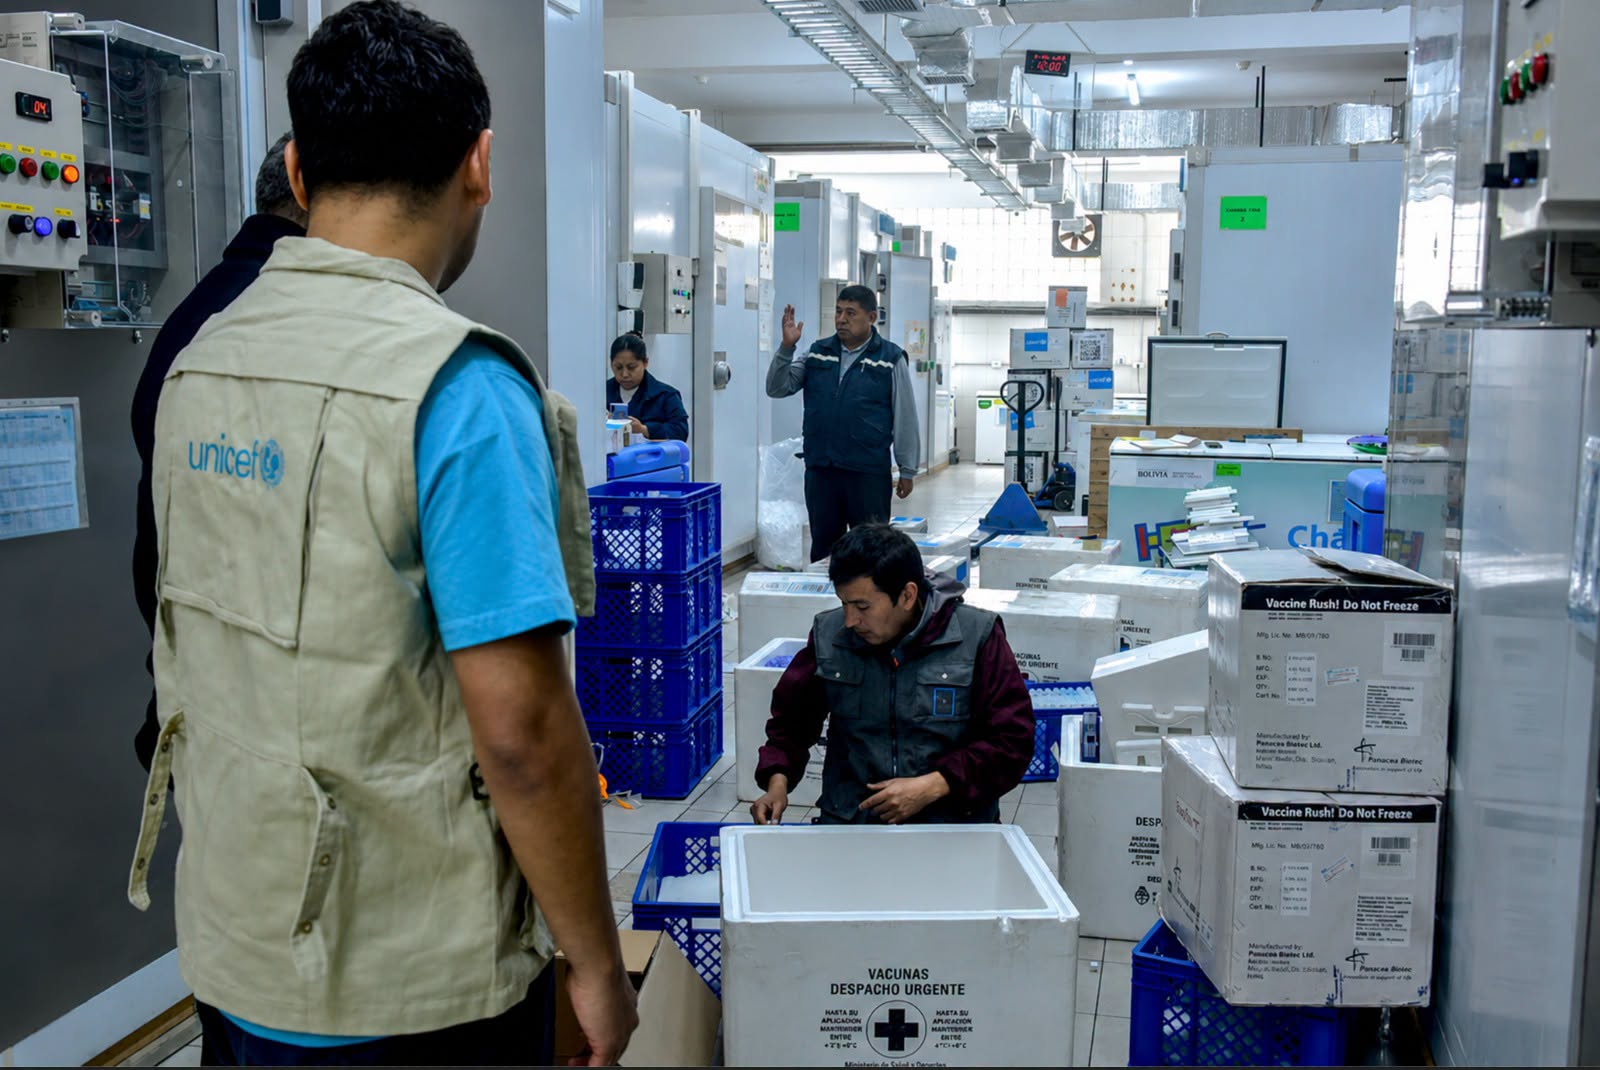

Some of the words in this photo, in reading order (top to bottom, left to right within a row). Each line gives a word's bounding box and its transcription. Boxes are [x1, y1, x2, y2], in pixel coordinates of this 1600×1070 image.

[188, 432, 259, 480] unicef
[1266, 598, 1306, 609] Vaccine
[1309, 598, 1339, 609] Rush!
[1343, 600, 1358, 610] Do
[1361, 600, 1381, 610] Not
[1384, 600, 1419, 611] Freeze
[1029, 661, 1059, 669] URGENTE
[1261, 806, 1303, 817] Vaccine
[1305, 807, 1334, 818] Rush!
[1338, 808, 1354, 818] Do
[1356, 808, 1376, 819] Not
[1378, 808, 1413, 819] Freeze
[1136, 817, 1162, 827] DESP
[868, 968, 929, 980] VACUNAS
[830, 983, 900, 996] DESPACHO
[905, 984, 965, 996] URGENTE
